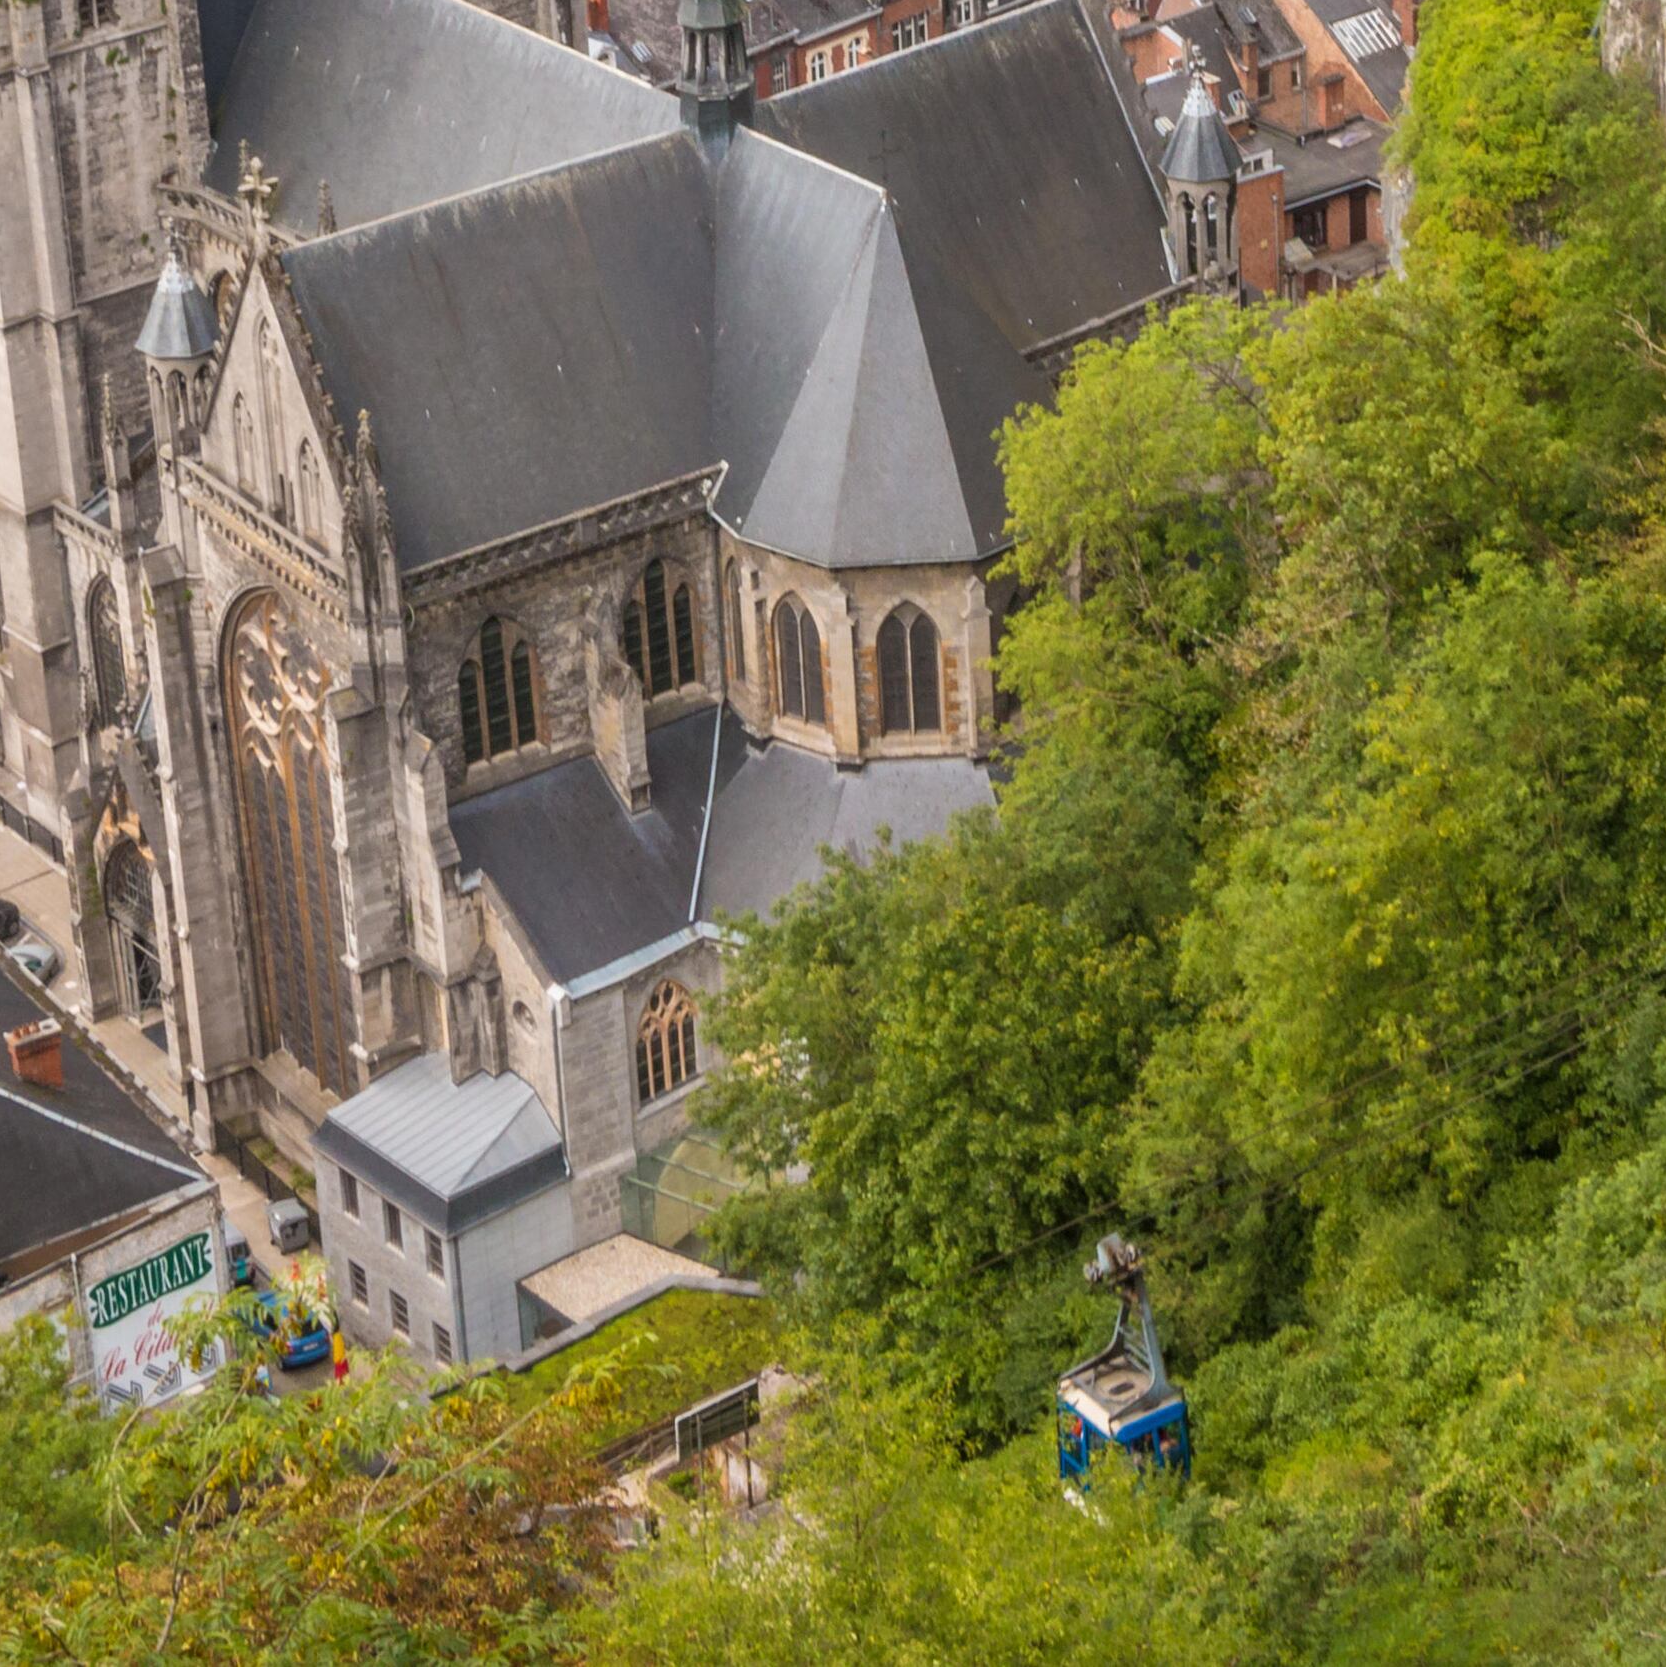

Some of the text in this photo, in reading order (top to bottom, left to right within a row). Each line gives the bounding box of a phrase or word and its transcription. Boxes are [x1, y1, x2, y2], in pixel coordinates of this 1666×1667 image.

[96, 1237, 204, 1324] RESTAURANT
[147, 1301, 164, 1328] de
[103, 1346, 126, 1383] La
